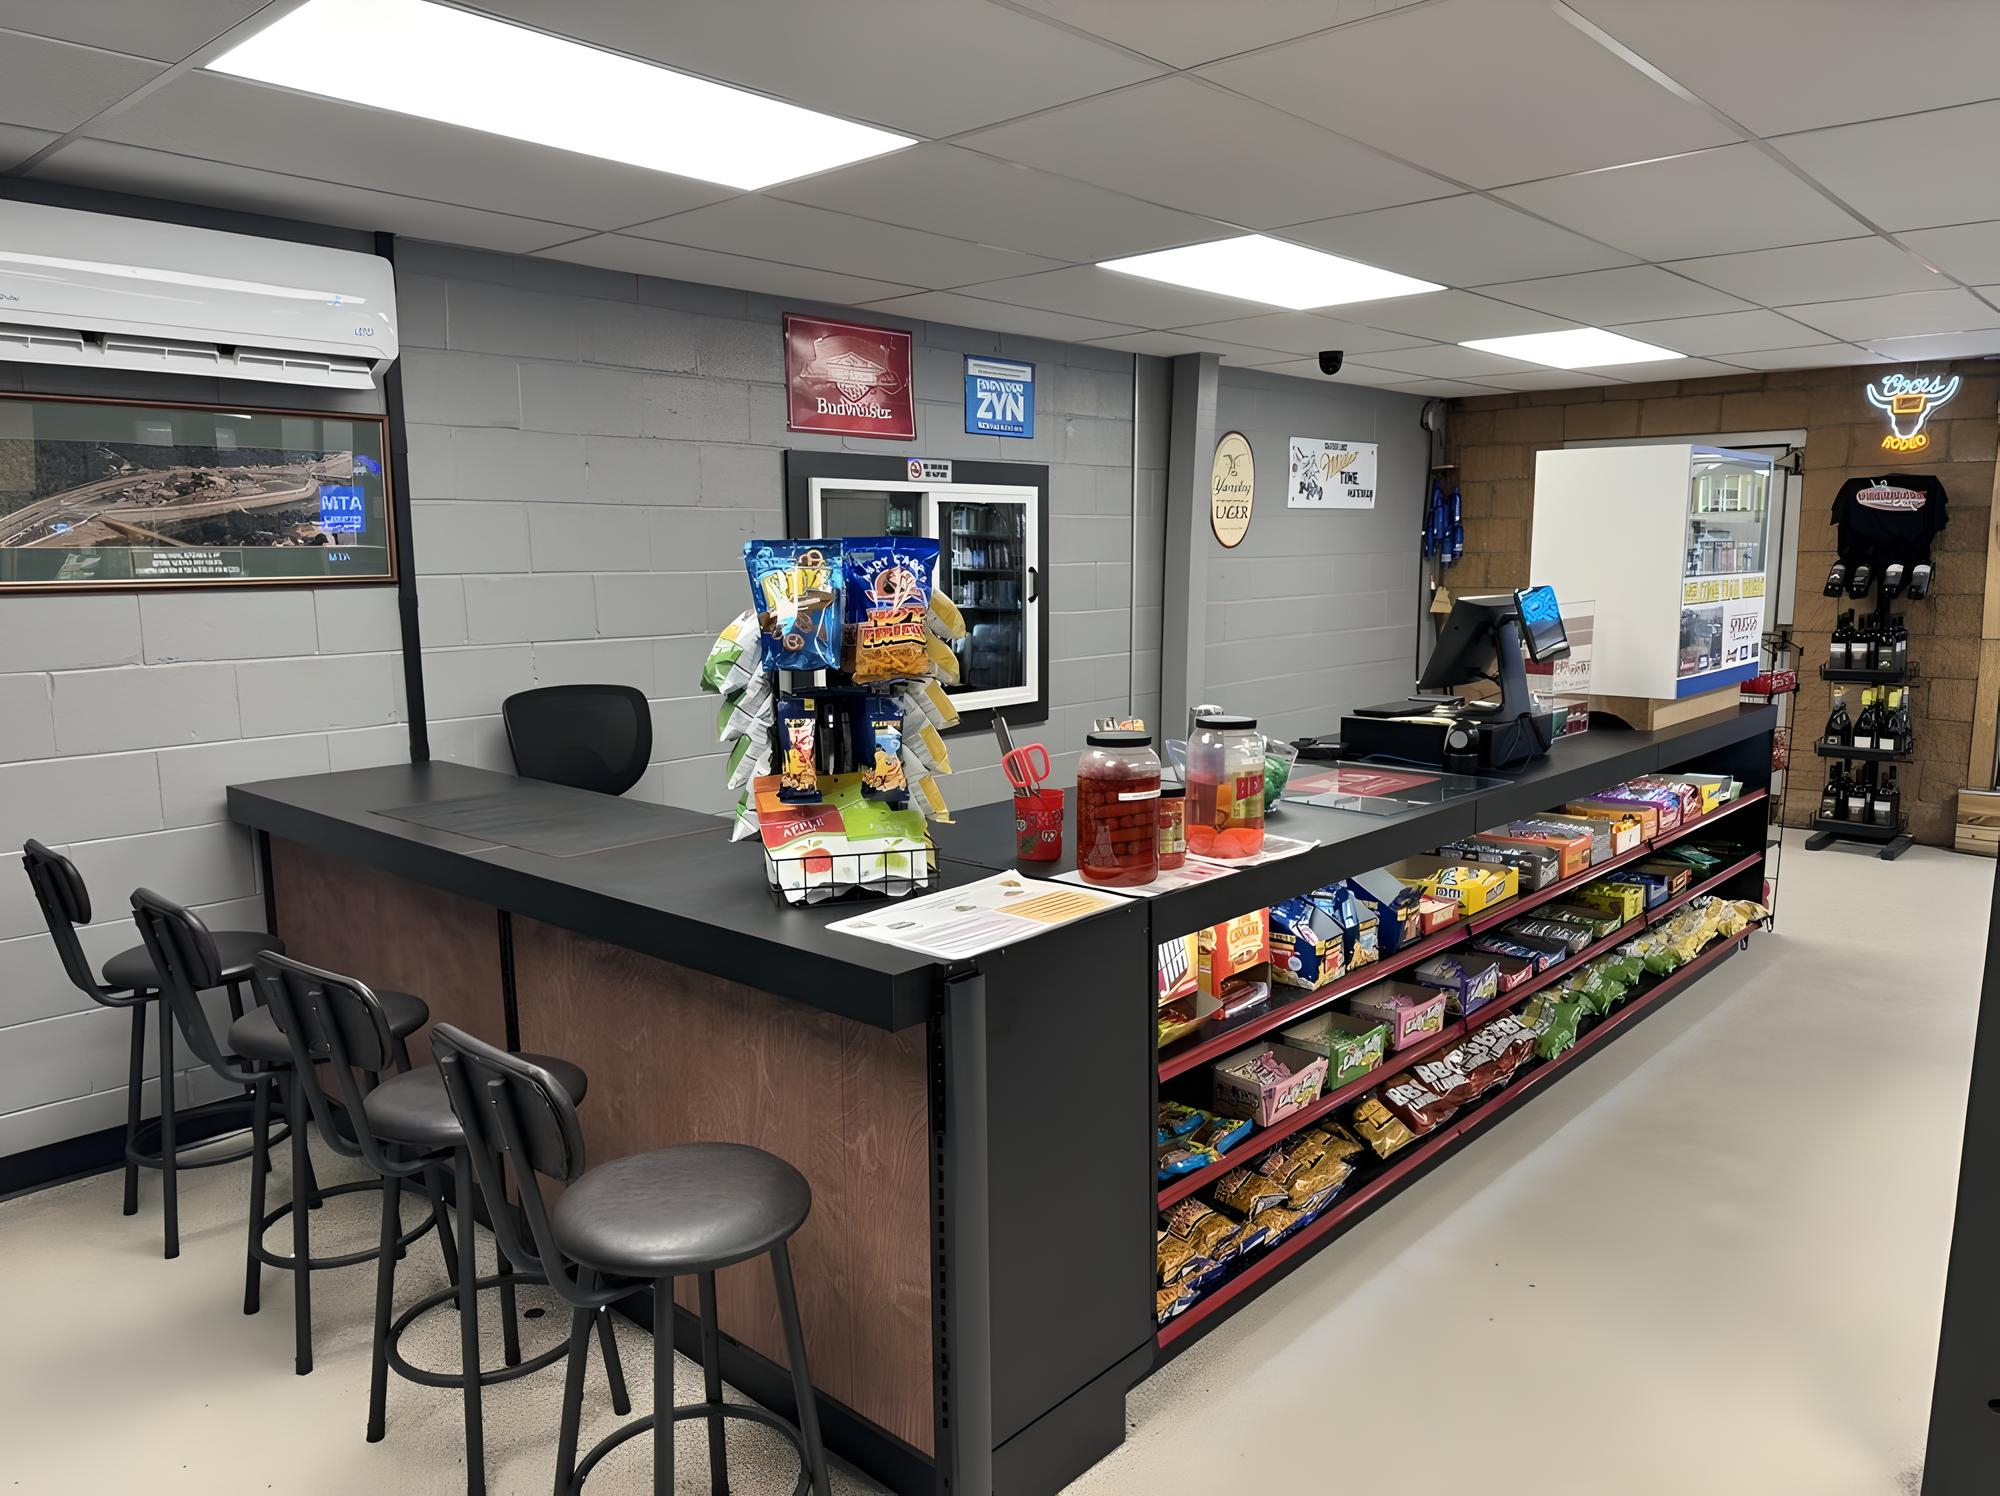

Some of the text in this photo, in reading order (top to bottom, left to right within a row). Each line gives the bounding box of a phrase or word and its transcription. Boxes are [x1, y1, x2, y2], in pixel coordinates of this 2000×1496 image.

[1882, 373, 1945, 396] Coors
[976, 392, 1024, 424] ZYN
[321, 494, 362, 512] MTA
[783, 817, 824, 838] APPLE
